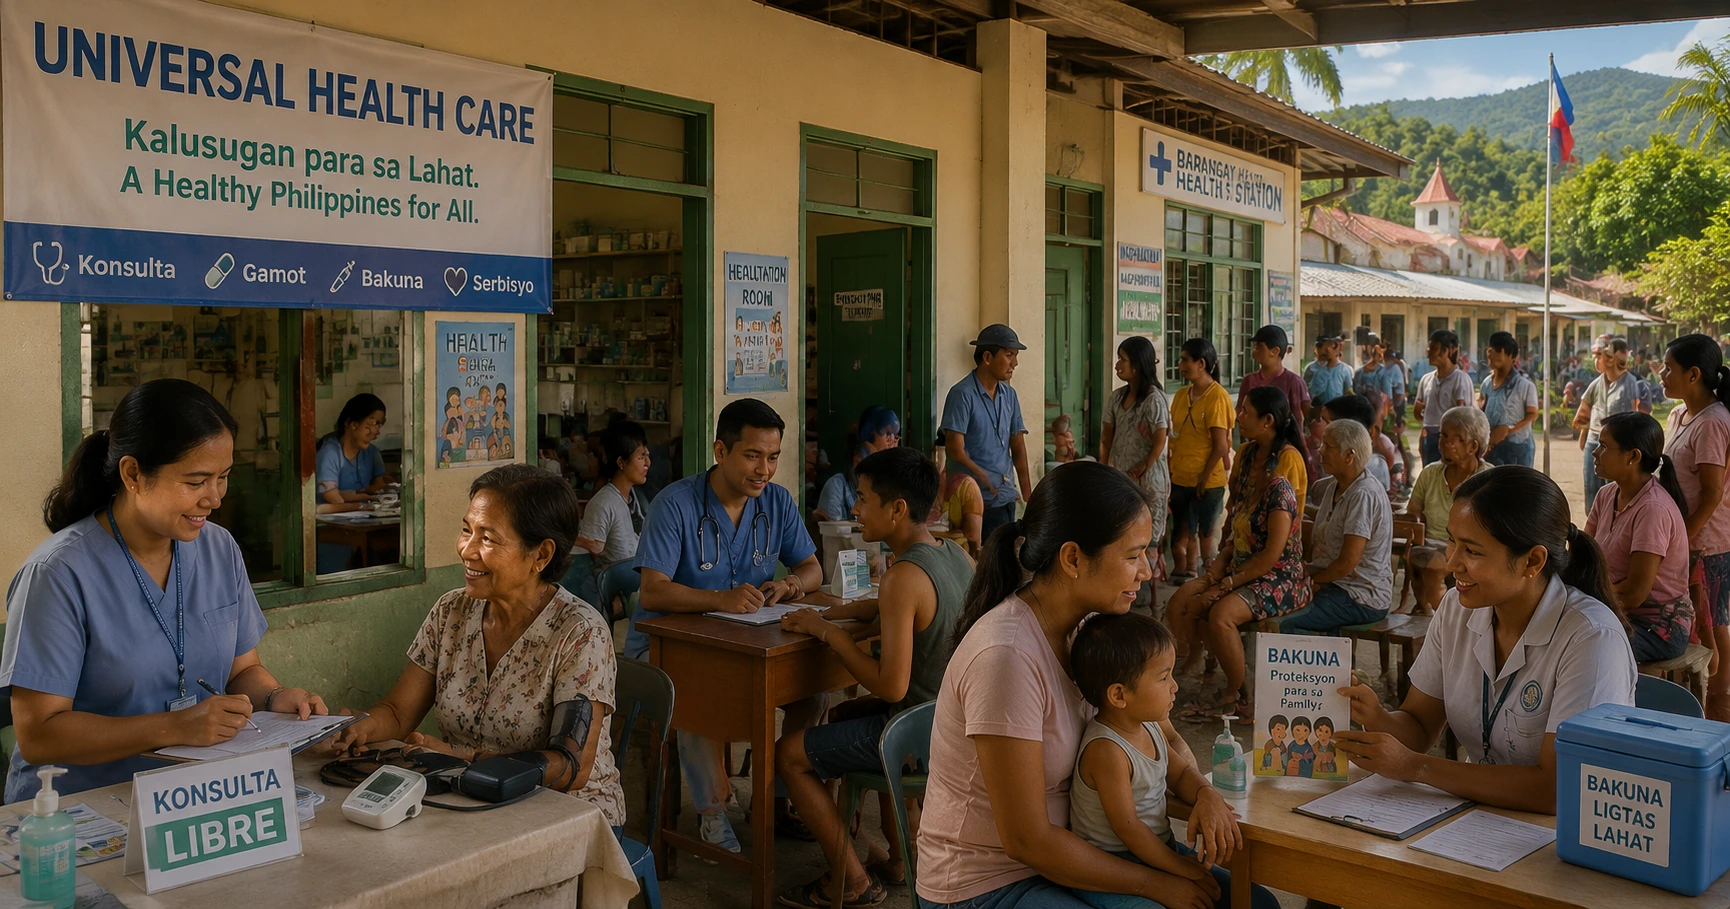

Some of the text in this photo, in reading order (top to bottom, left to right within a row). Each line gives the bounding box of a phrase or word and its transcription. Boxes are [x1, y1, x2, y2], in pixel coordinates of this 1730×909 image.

[34, 20, 535, 145] UNIVERSAL HEALTH CARE
[125, 117, 479, 189] Kalusugan para sa Lahat.
[1177, 148, 1236, 182] BARANGAY
[119, 165, 479, 225] A Healthy Philippines for All.
[1176, 170, 1223, 200] HEALTH
[78, 254, 176, 279] Konsulta
[242, 263, 307, 285] Gamot
[361, 269, 424, 290] Bakuna
[472, 274, 535, 297] Serbisyo
[1268, 647, 1340, 667] BAKUNA
[1270, 669, 1336, 686] Proteksyon
[1284, 687, 1308, 697] para
[153, 768, 282, 815] KONSULTA
[1587, 774, 1664, 808] BAKUNA
[1593, 799, 1656, 830] LIGTAS
[165, 807, 278, 864] LIBRE
[1593, 823, 1654, 853] LAHAT
